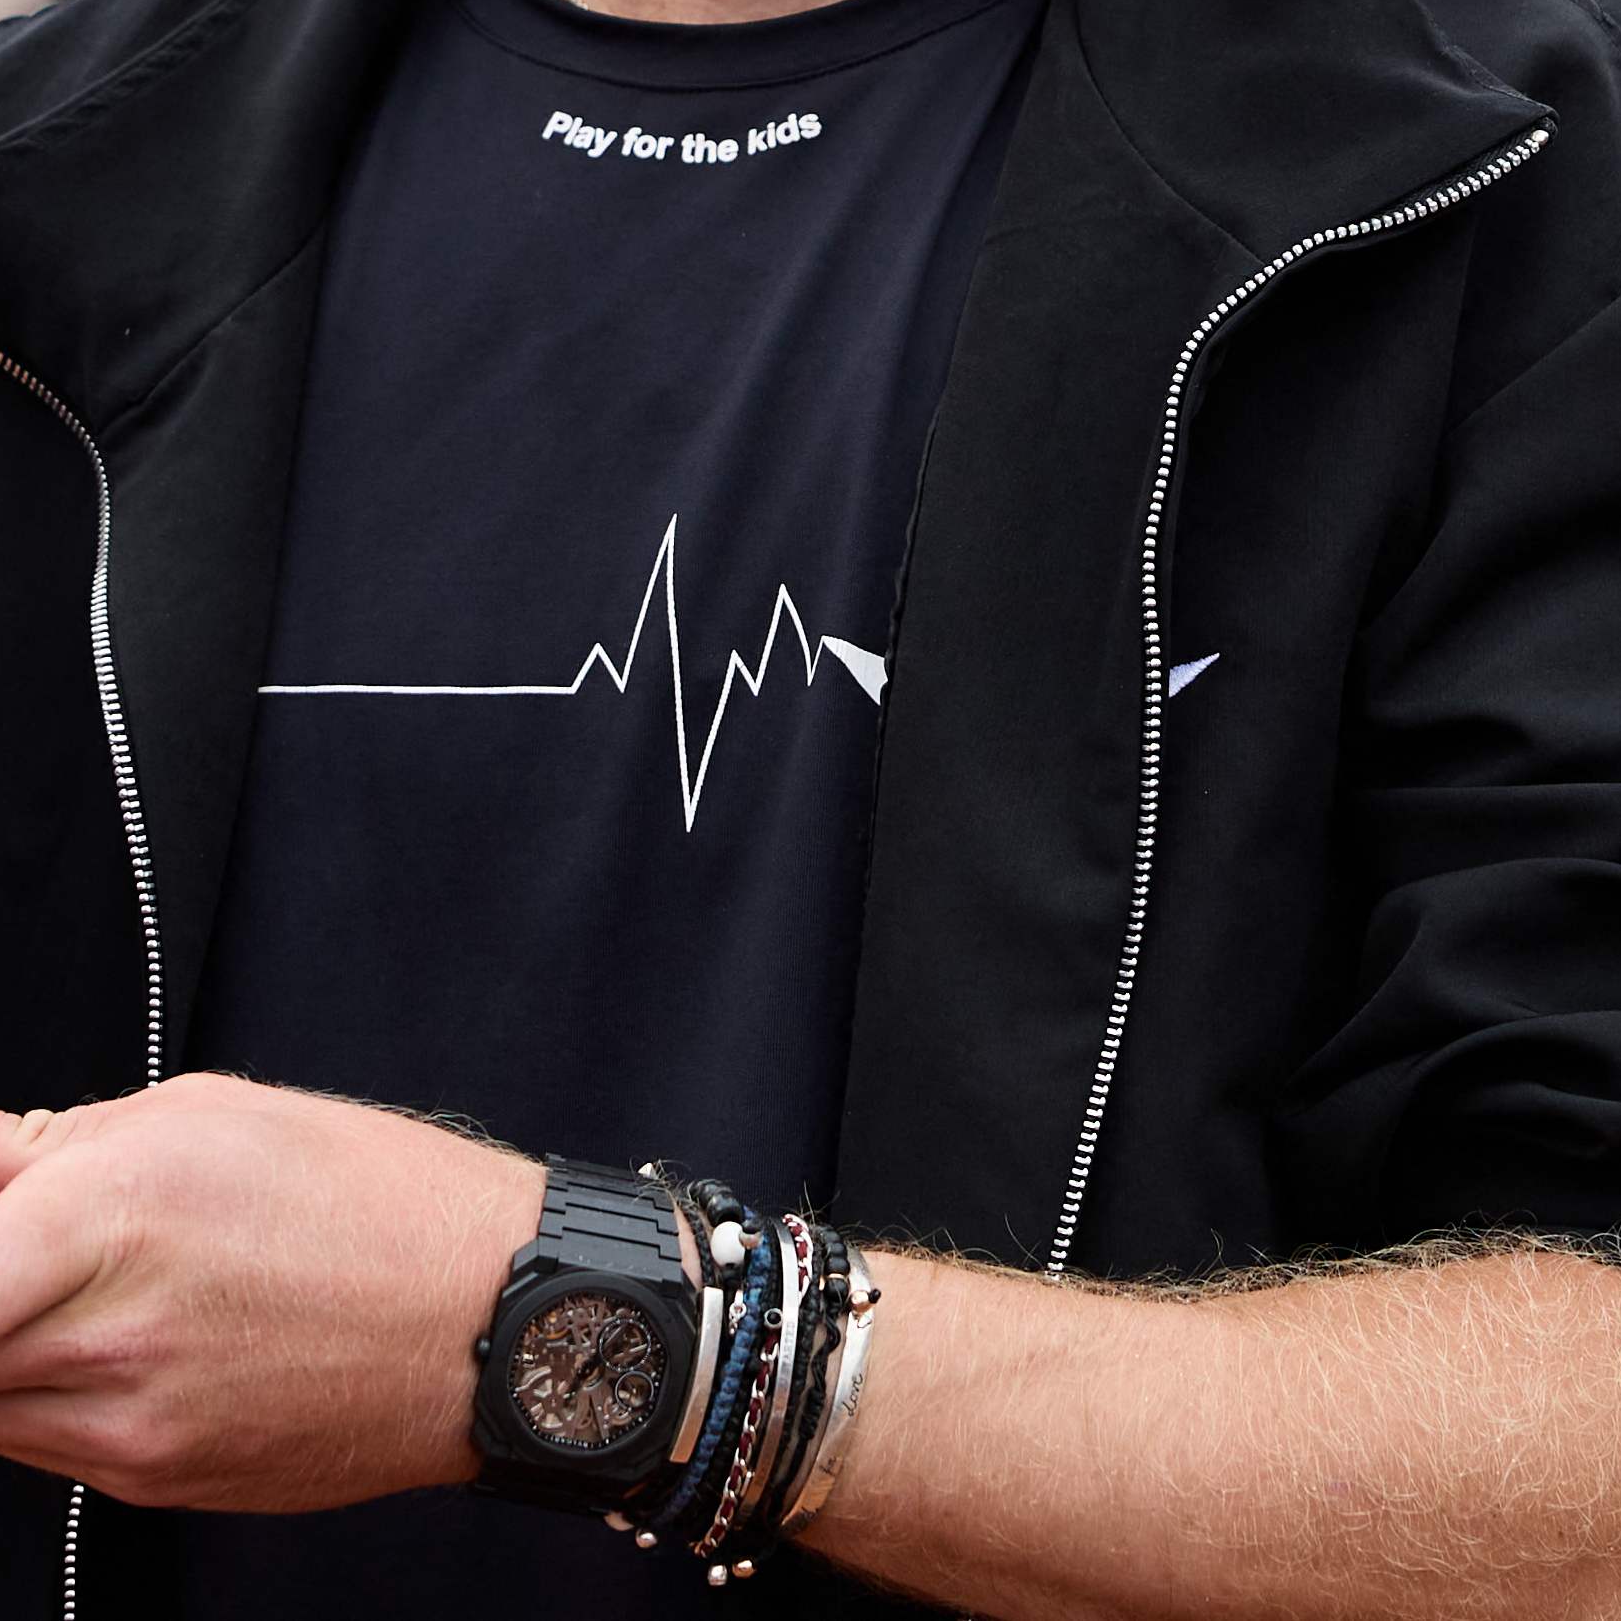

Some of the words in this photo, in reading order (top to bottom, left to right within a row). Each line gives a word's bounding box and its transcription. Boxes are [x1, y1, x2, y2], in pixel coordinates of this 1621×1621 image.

[542, 111, 618, 158] Play
[621, 127, 674, 160] for
[681, 133, 739, 164] the
[747, 112, 823, 155] kids
